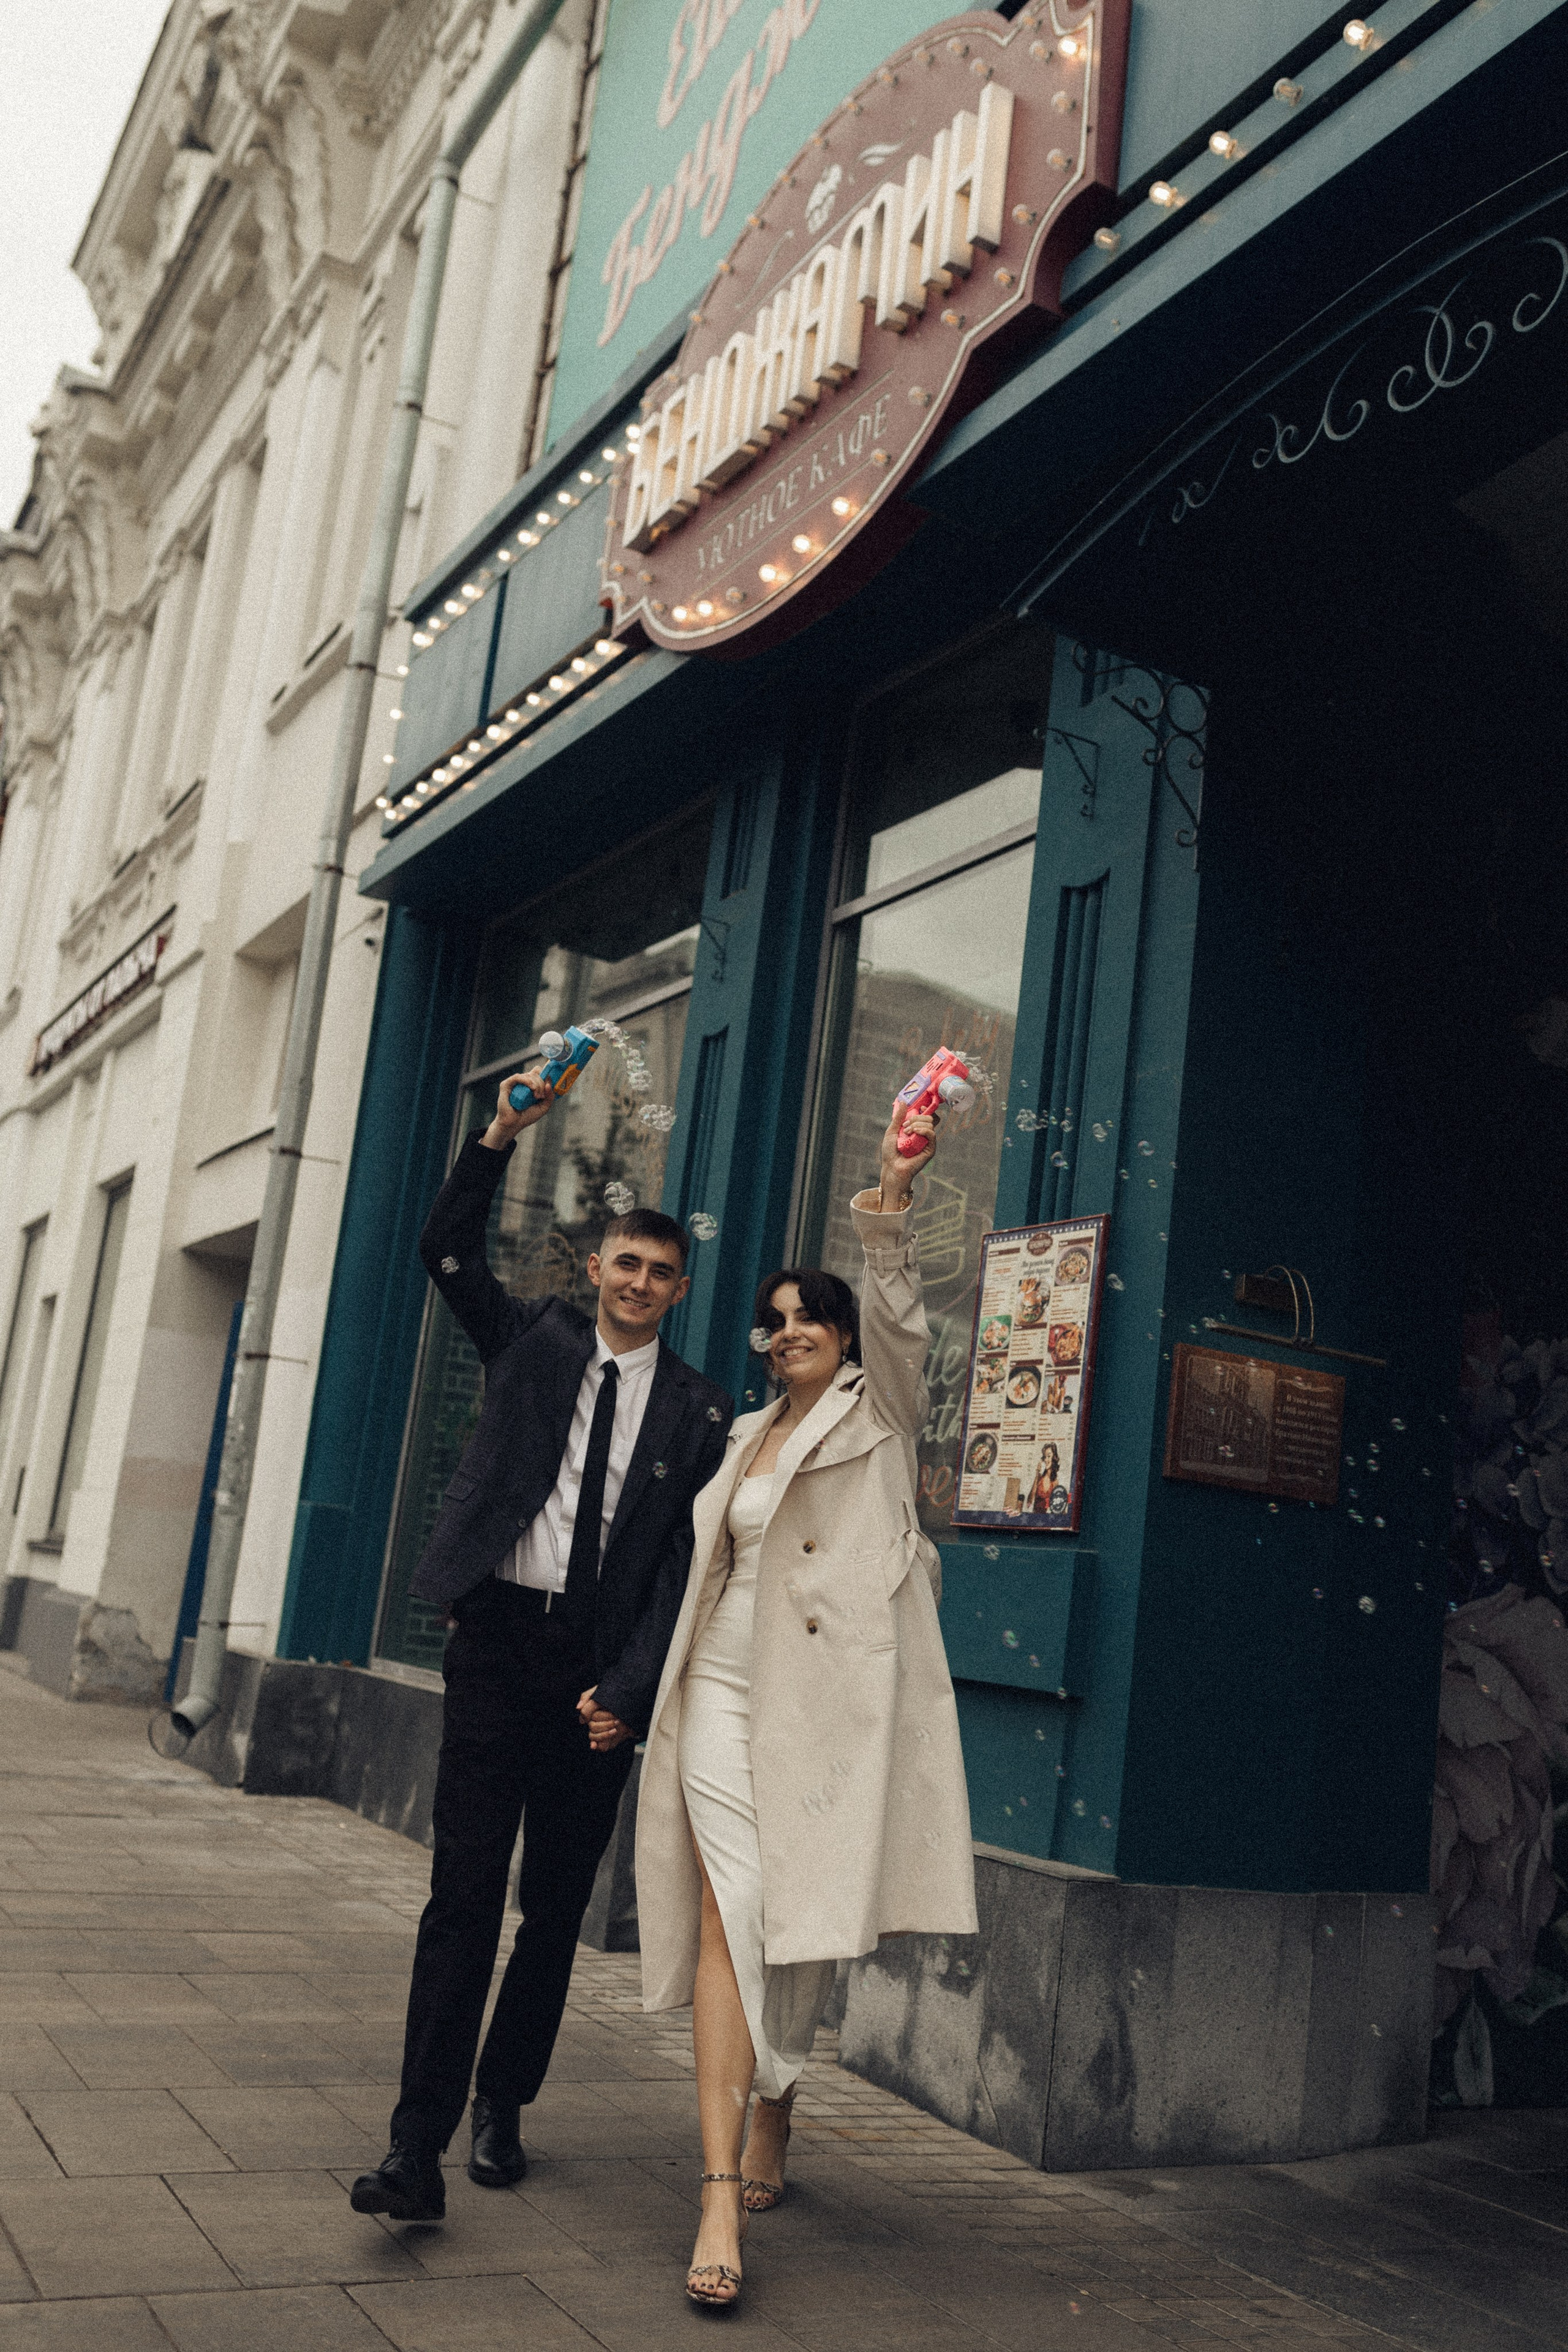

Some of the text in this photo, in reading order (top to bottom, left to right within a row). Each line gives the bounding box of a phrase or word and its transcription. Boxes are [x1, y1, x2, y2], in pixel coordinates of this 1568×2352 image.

[623, 81, 1015, 553] БЕНДЖАМИН
[696, 392, 891, 581] УЮТНОЕ КАФЕ
